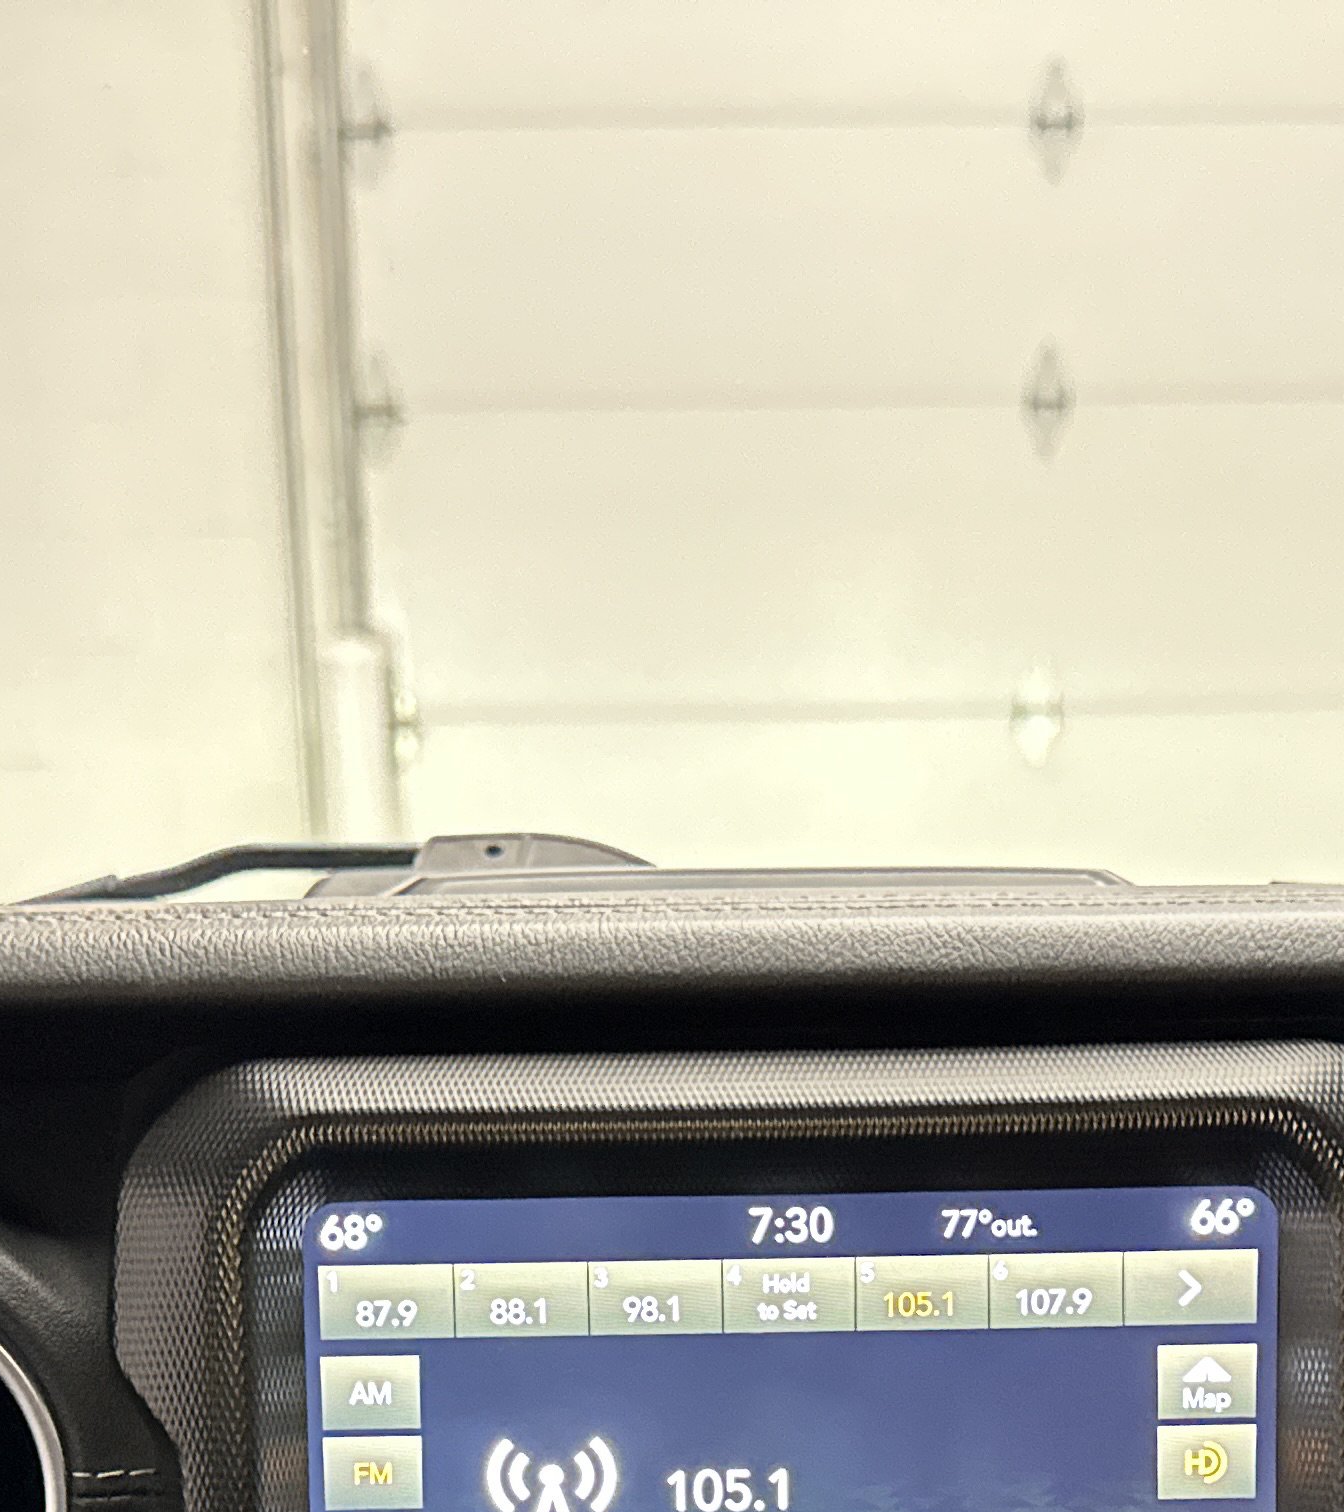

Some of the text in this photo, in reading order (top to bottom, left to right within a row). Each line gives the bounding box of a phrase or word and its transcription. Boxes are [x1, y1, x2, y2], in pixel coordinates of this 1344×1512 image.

[748, 1206, 834, 1244] 7:30
[1190, 1197, 1255, 1236] 66°
[320, 1213, 383, 1251] 68°
[326, 1270, 339, 1292] 1
[460, 1270, 476, 1291] 2
[594, 1268, 609, 1289] 3
[726, 1265, 742, 1286] 4
[860, 1261, 875, 1283] 5
[993, 1260, 1009, 1280] 6
[762, 1273, 810, 1294] Hold
[356, 1299, 418, 1327] 87.9
[490, 1297, 548, 1325] 88.1
[623, 1296, 681, 1323] 98.1
[757, 1300, 817, 1321] to Set
[883, 1290, 954, 1318] 105.1
[1016, 1287, 1093, 1315] 107.9
[349, 1381, 392, 1406] AM
[1182, 1387, 1231, 1412] Map
[354, 1462, 393, 1486] FM
[667, 1468, 790, 1512] 105.1
